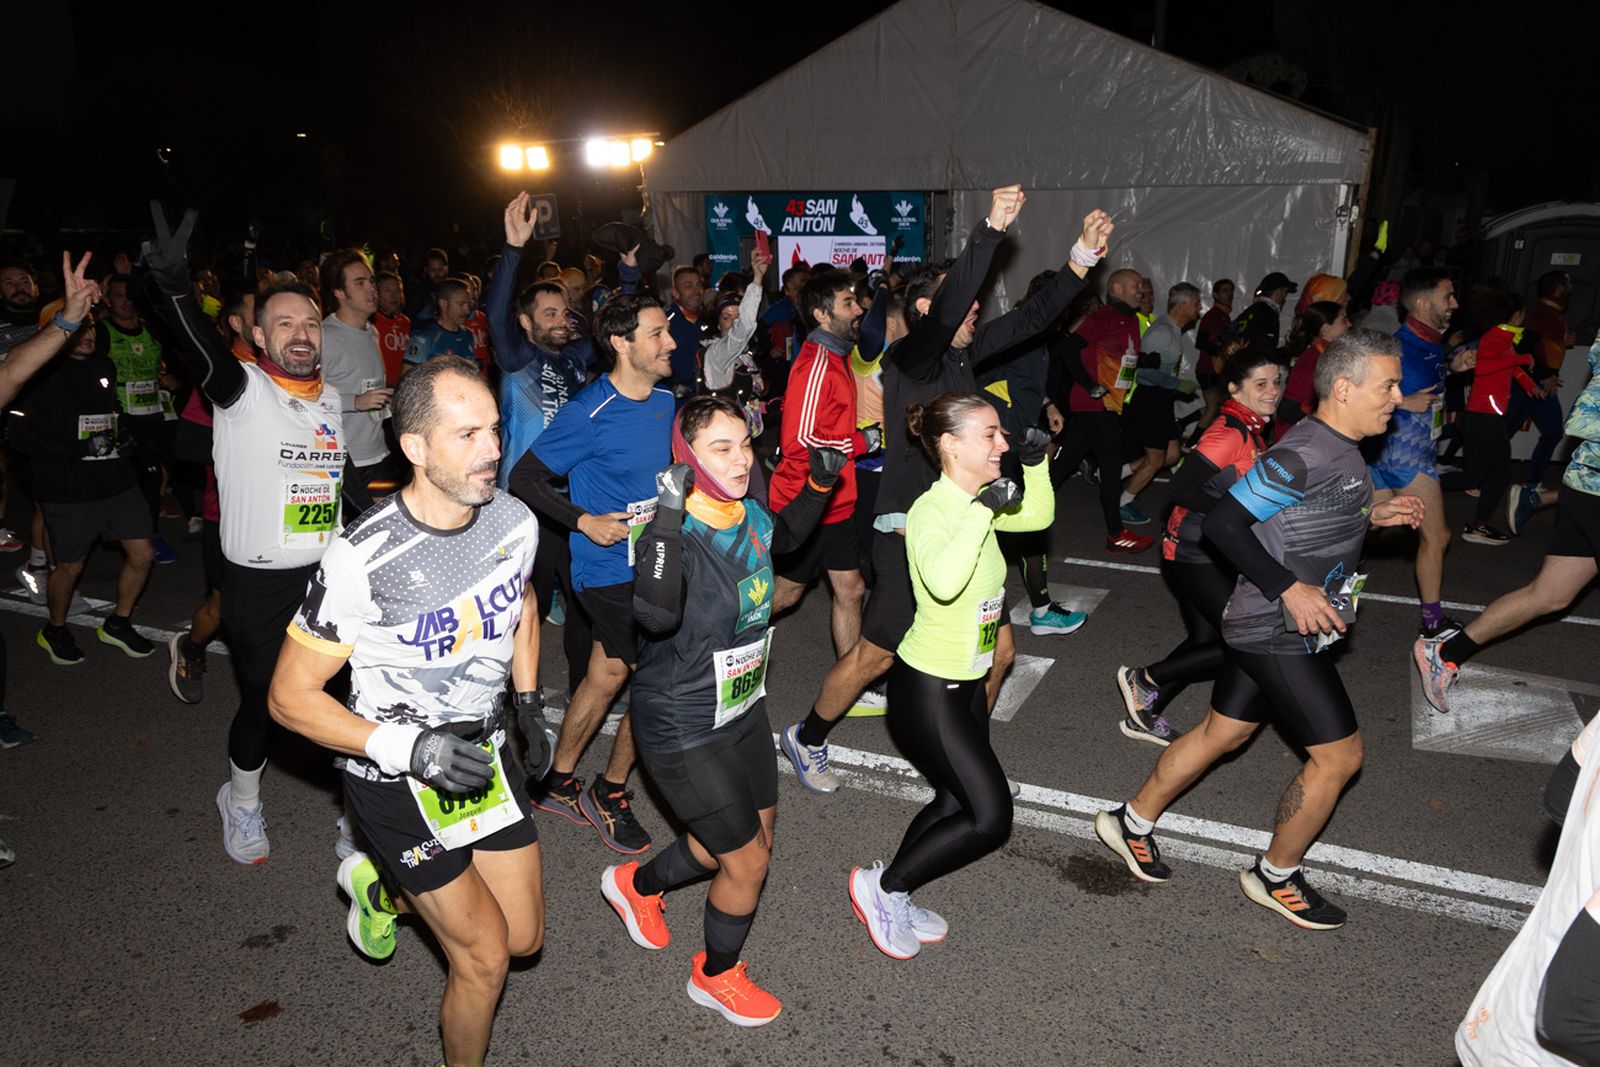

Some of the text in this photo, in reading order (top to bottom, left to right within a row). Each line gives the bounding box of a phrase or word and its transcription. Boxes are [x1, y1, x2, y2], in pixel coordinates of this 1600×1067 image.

[781, 215, 836, 233] ANTÓN
[857, 216, 869, 229] 43
[832, 253, 857, 265] SAN
[300, 485, 330, 495] NOCHE DE
[290, 495, 306, 504] SAN
[653, 541, 665, 580] KIPRUN
[735, 651, 756, 665] NOCHE
[726, 665, 742, 679] SAN
